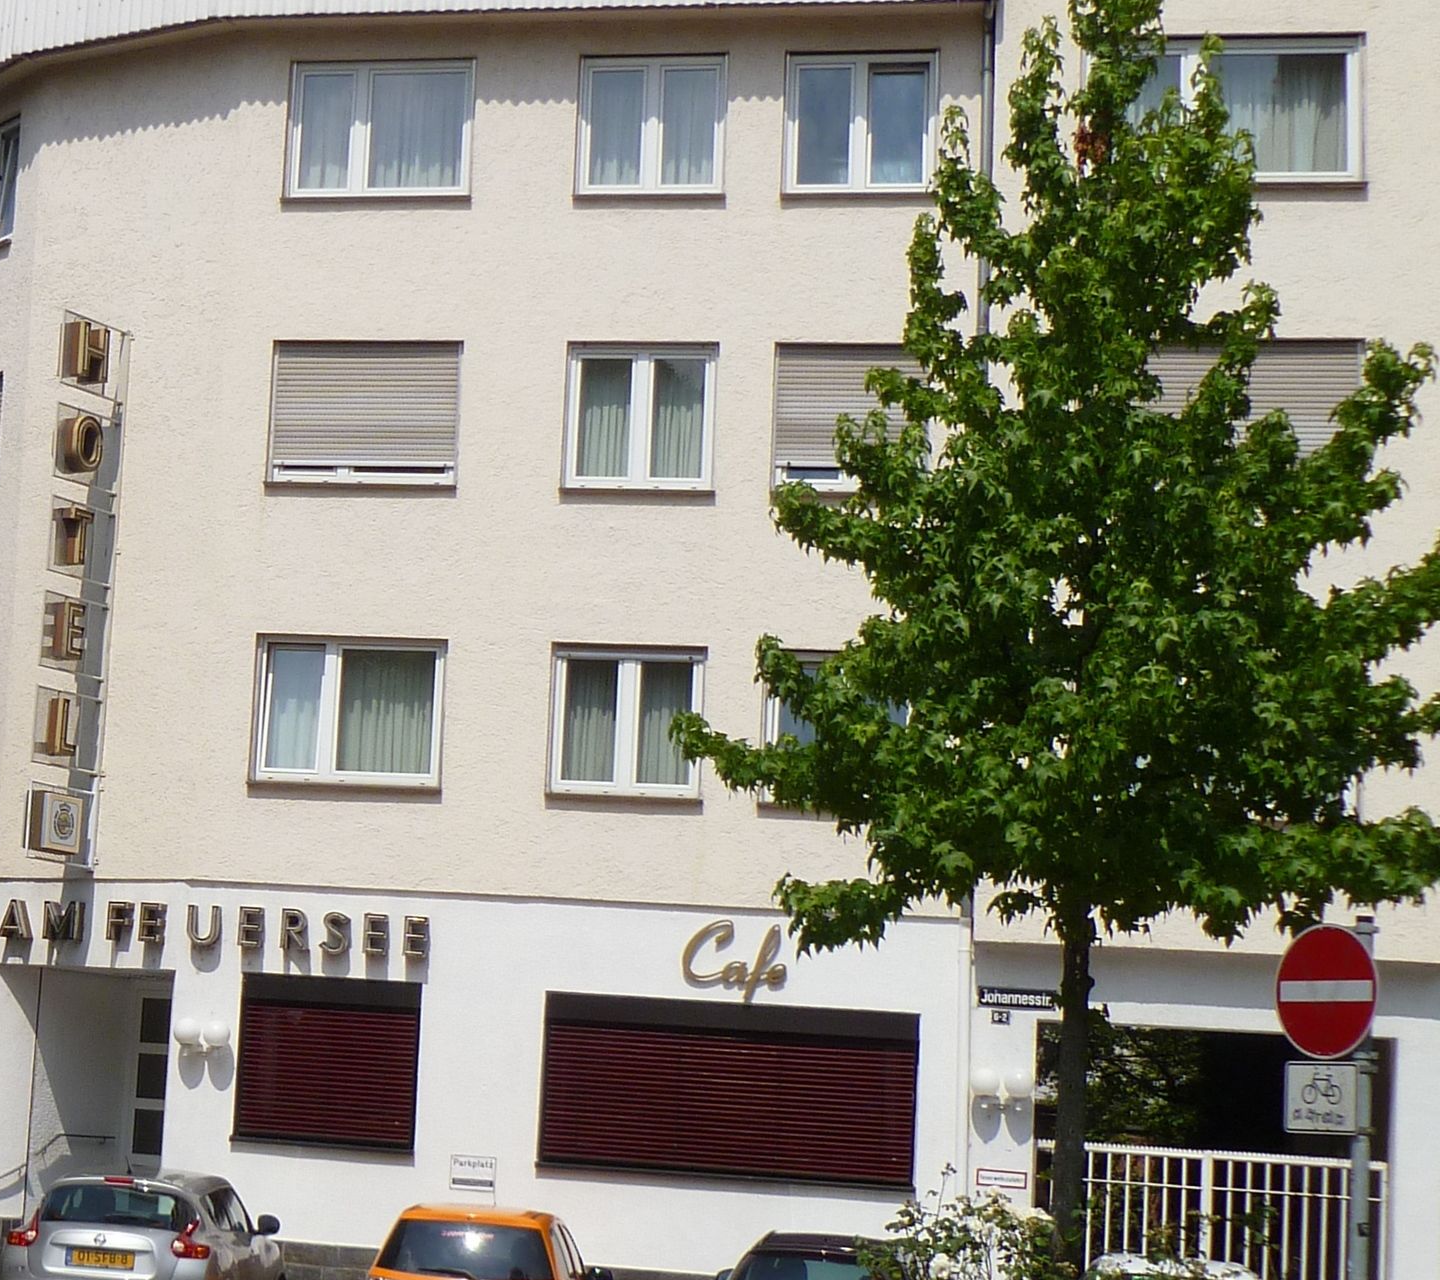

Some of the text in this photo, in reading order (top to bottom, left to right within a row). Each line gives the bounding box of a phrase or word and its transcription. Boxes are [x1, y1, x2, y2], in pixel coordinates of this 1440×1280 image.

[46, 317, 111, 757] HOTEL
[105, 901, 431, 957] FEUERSEE
[682, 919, 787, 1004] Cafe
[980, 989, 1053, 1007] Johannesstr.
